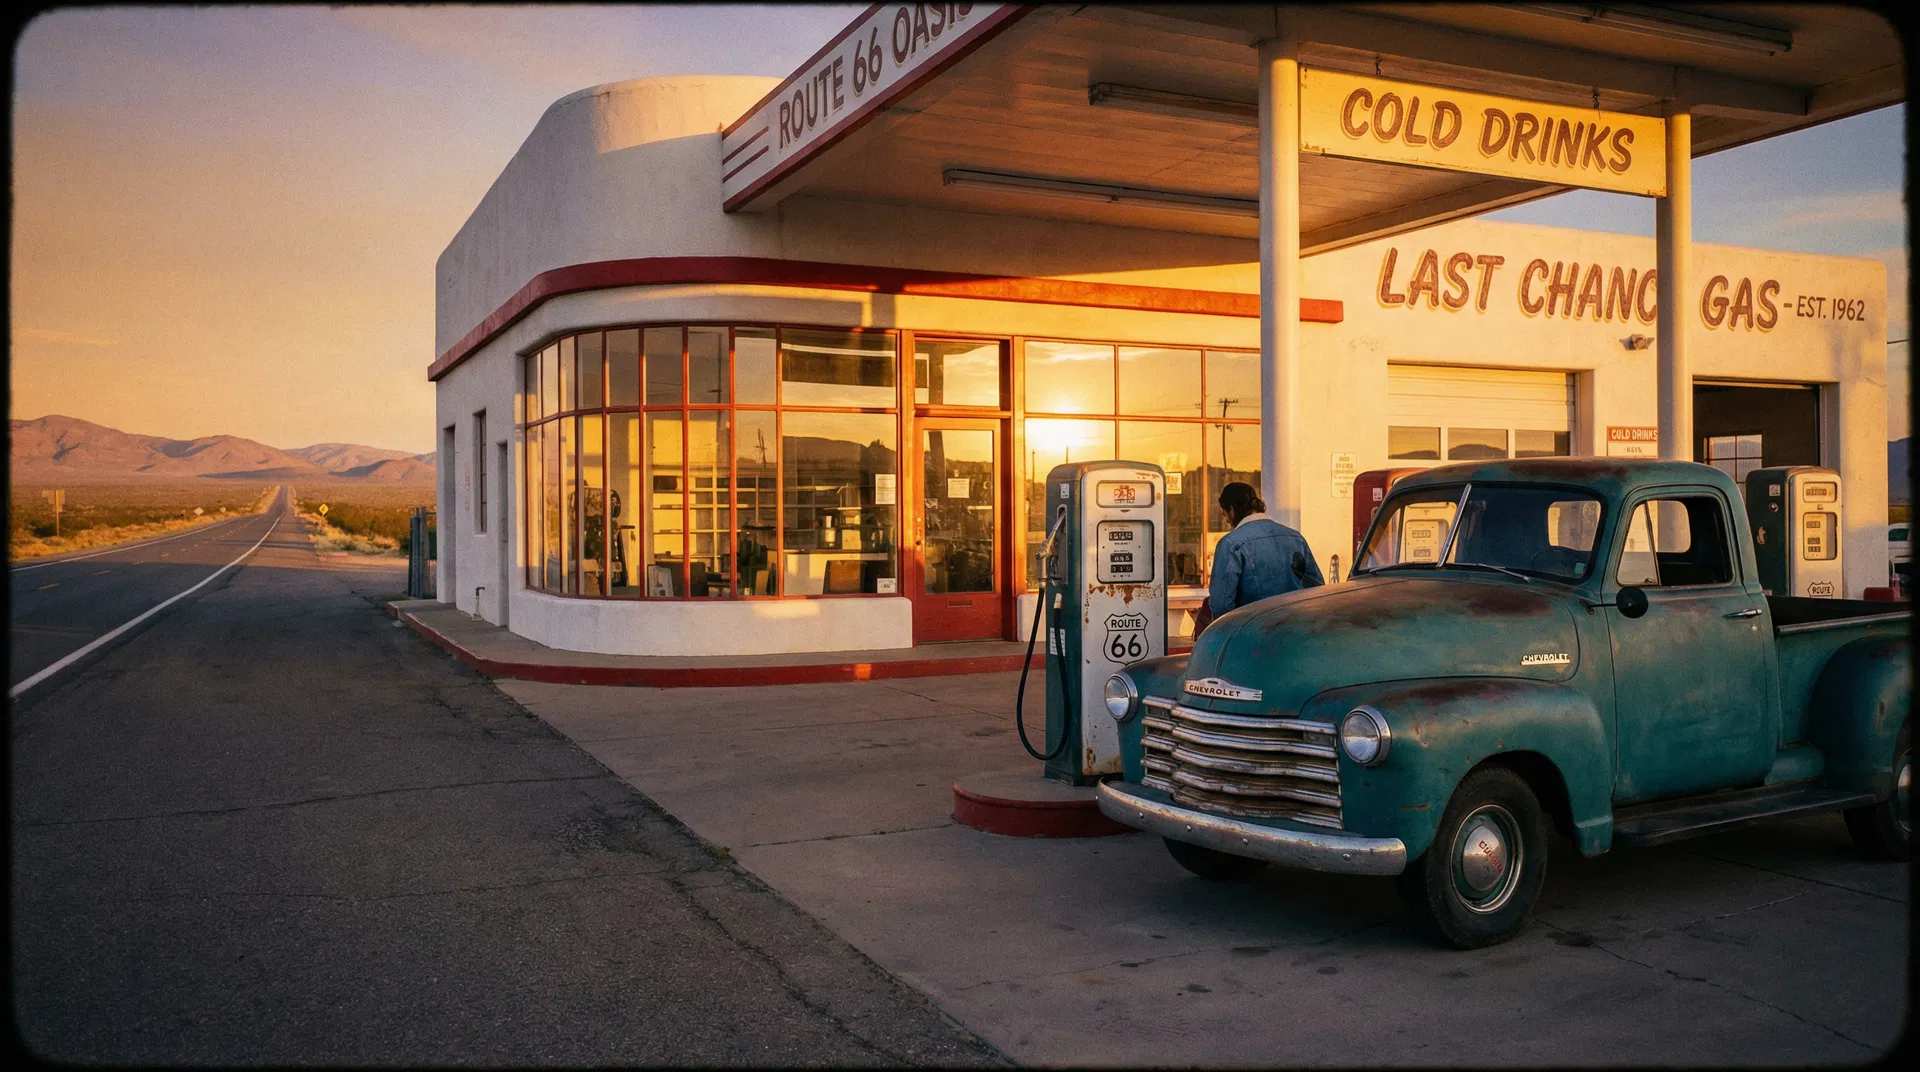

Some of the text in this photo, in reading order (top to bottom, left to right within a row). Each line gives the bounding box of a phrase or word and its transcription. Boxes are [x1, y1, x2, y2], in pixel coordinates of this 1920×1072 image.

[779, 4, 974, 150] ROUTE 66 OAS
[1341, 88, 1635, 173] COLD DRINKS
[1379, 247, 1505, 312] LAST
[1519, 258, 1657, 324] CHANC
[1701, 275, 1780, 331] GAS
[1797, 295, 1827, 319] EST.
[1832, 298, 1865, 321] 1962
[1611, 428, 1630, 440] COLD
[1812, 586, 1831, 595] ROUTE
[1111, 618, 1141, 629] ROUTE
[1111, 633, 1142, 658] 66
[1522, 653, 1569, 662] CHEVROLET
